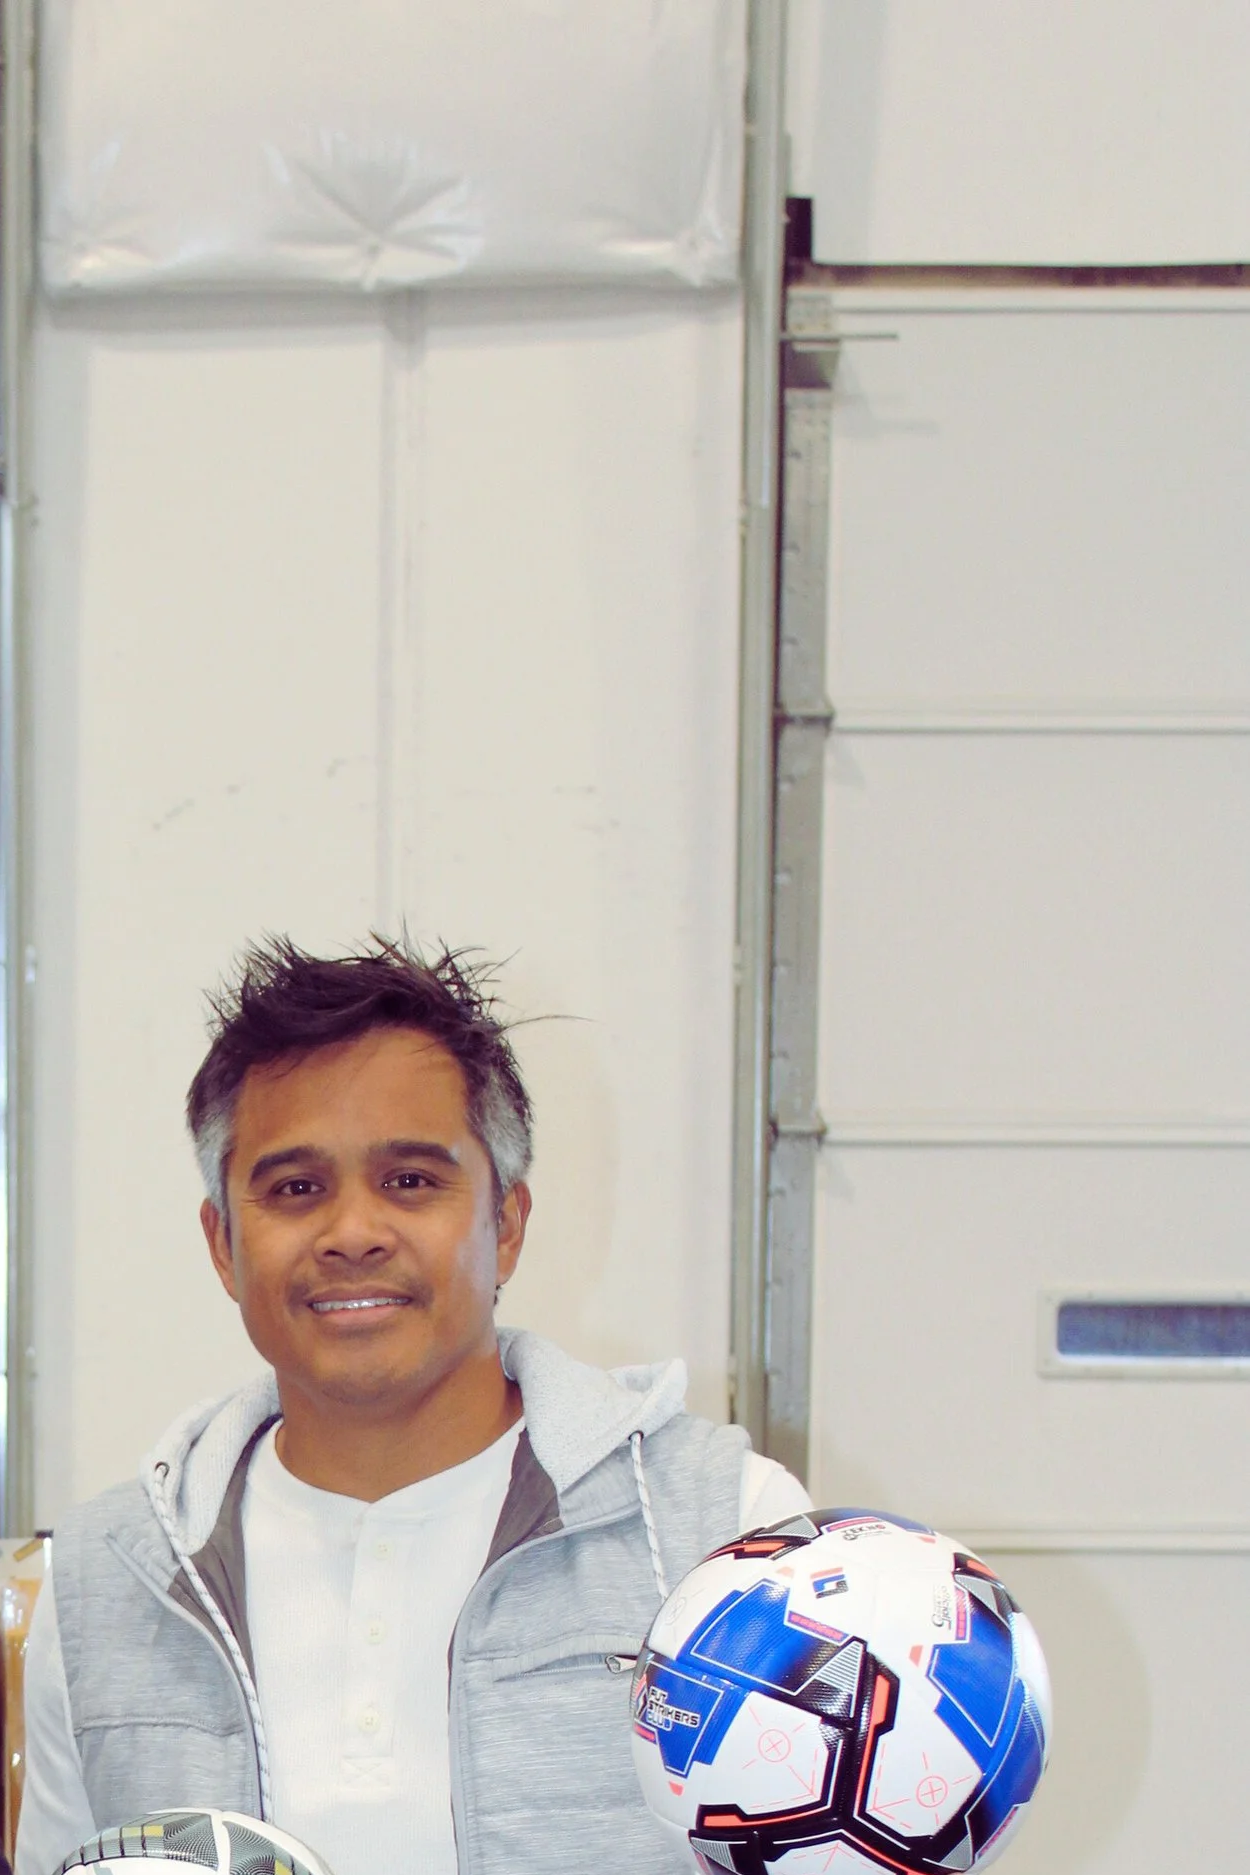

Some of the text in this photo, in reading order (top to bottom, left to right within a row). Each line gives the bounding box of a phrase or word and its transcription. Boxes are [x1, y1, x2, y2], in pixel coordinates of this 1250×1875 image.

[650, 1688, 667, 1702] FUT
[647, 1710, 671, 1730] CLUB
[648, 1699, 699, 1726] STRIKERS
